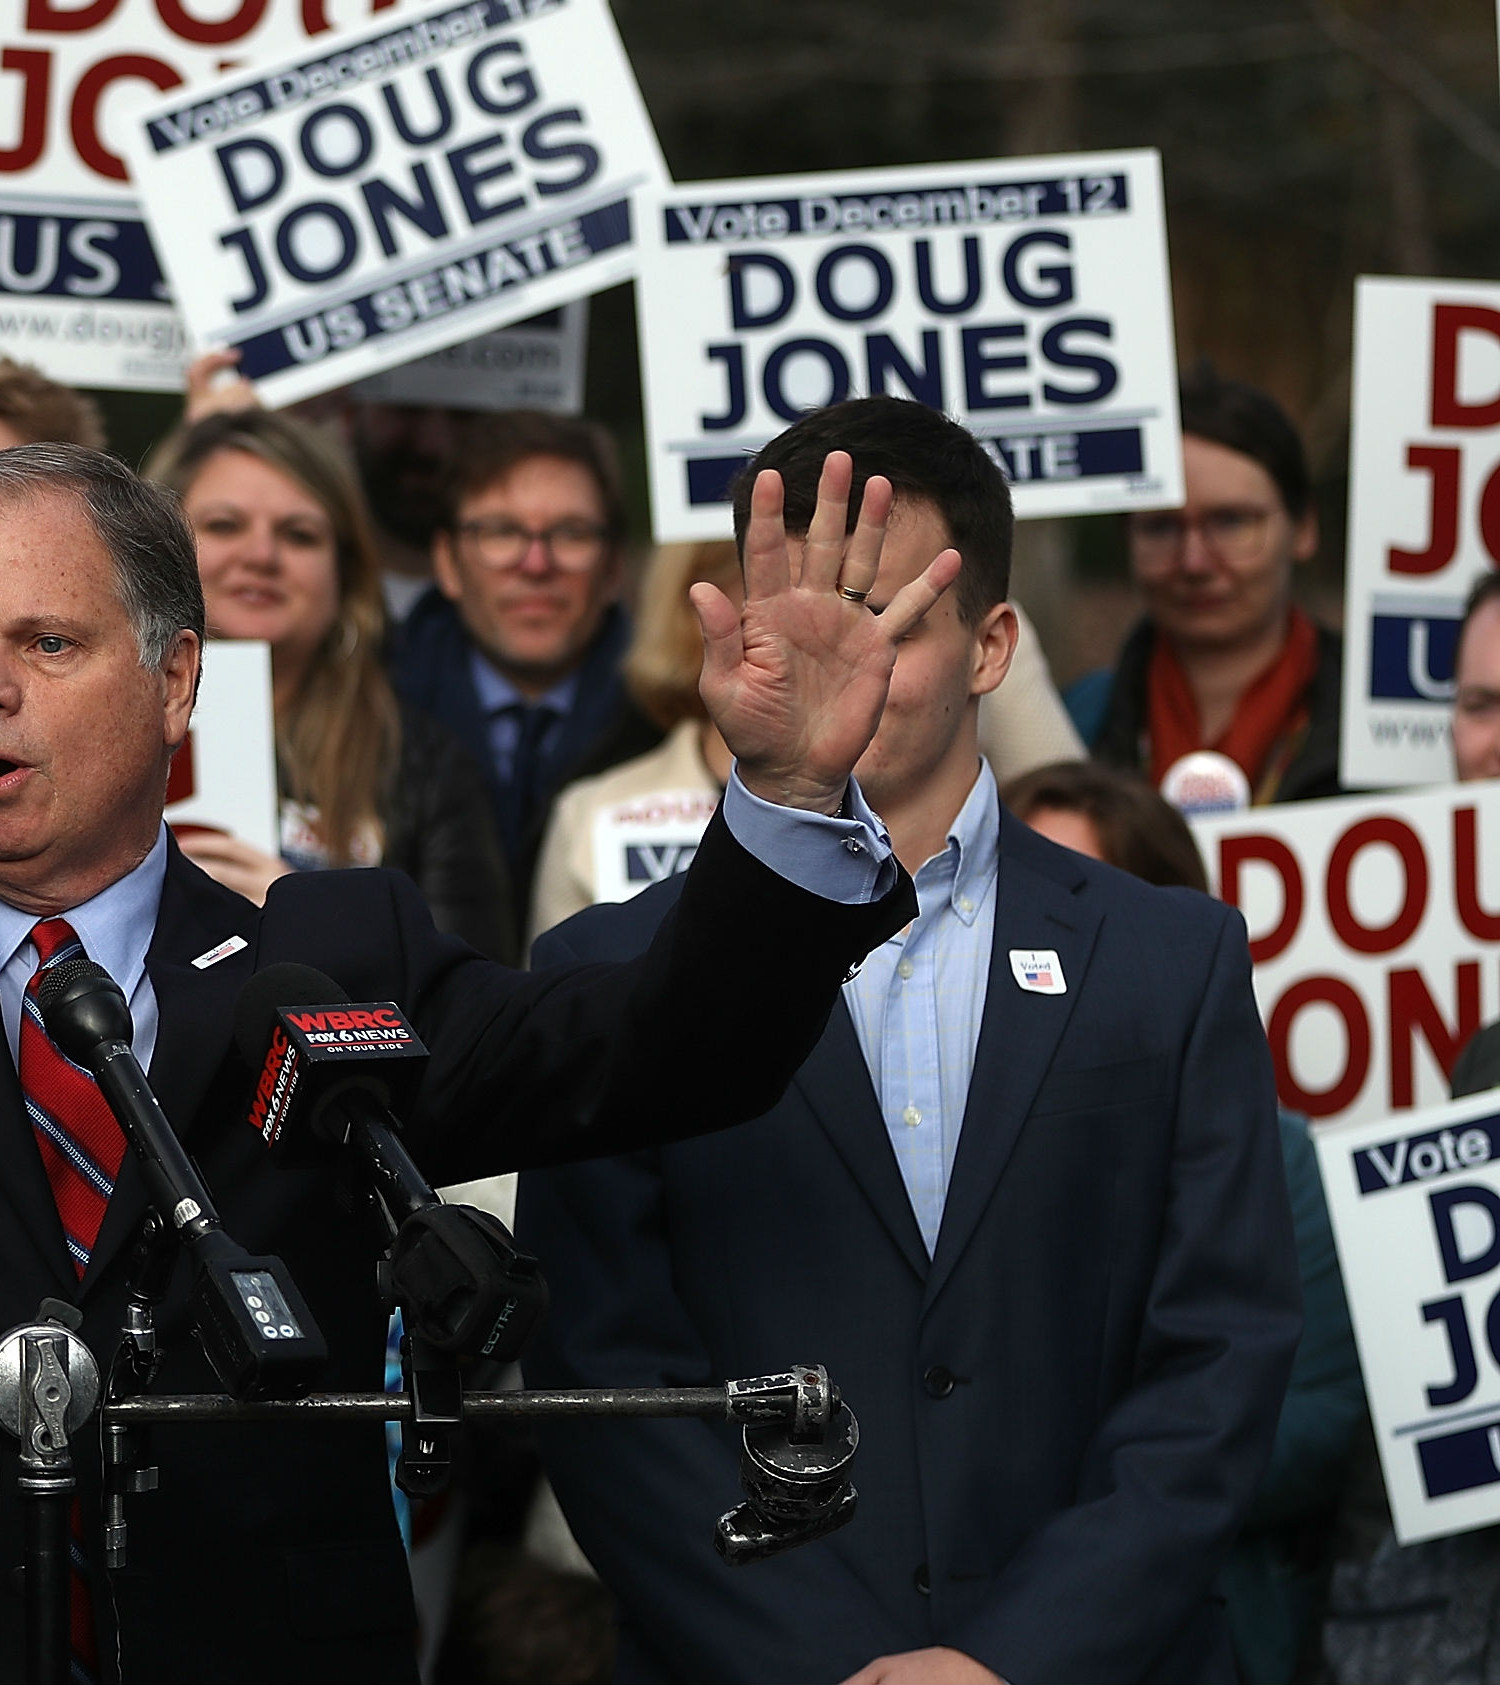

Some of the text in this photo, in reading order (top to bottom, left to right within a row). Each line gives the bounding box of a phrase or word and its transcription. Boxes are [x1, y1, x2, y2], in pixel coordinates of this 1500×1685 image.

[155, 86, 265, 146] Vote
[267, 7, 490, 105] December
[215, 38, 540, 213] DOUG
[219, 107, 603, 314] JONES
[676, 176, 1117, 241] Vote December 12
[281, 219, 591, 364] US SENATE
[726, 230, 1077, 330] DOUG
[702, 316, 1121, 431] JONES
[1386, 444, 1500, 578] J
[1020, 962, 1051, 971] Voted
[286, 1009, 402, 1032] WBRC
[305, 1028, 411, 1044] FOX 6 NEWS
[346, 1043, 377, 1052] YOUR
[248, 1025, 288, 1129] WBRC
[262, 1044, 297, 1142] FOX 6 NEWS
[274, 1070, 300, 1141] ON YOUR SIDE
[1366, 1128, 1493, 1187] Vote
[1420, 1295, 1500, 1408] J
